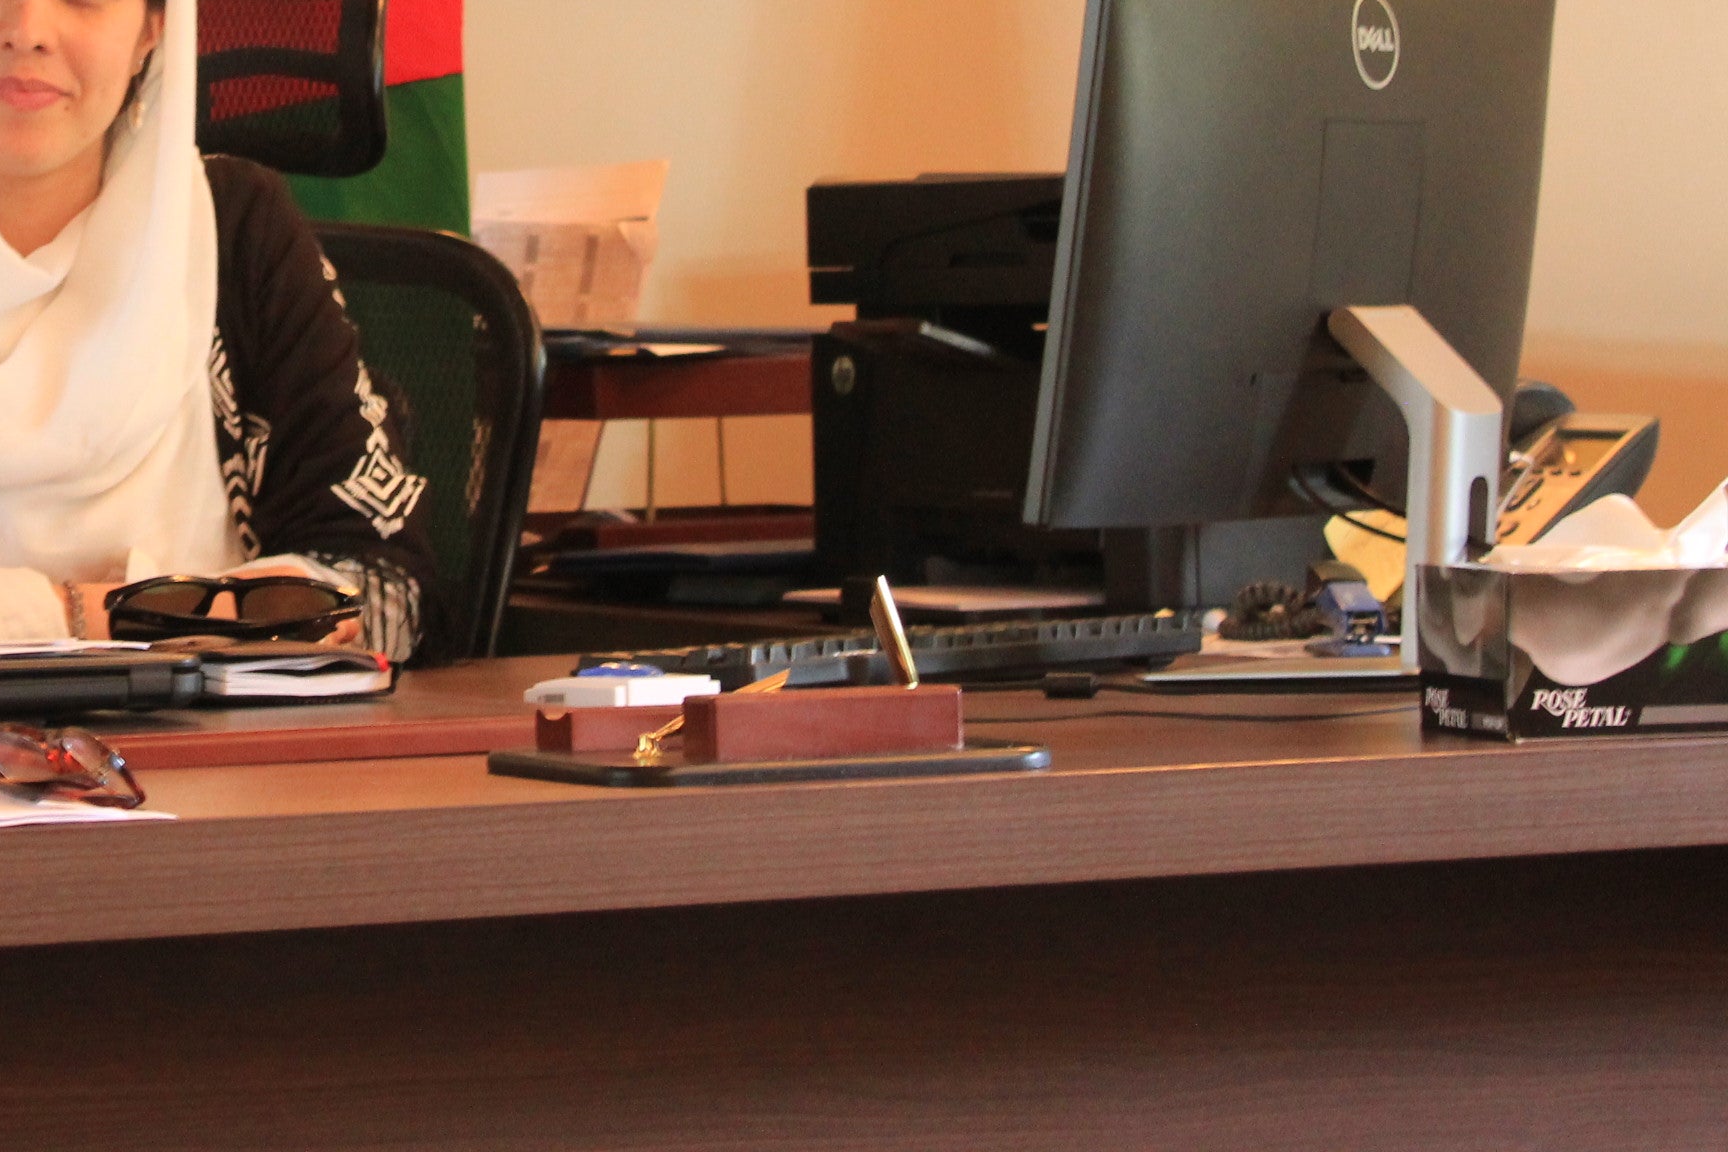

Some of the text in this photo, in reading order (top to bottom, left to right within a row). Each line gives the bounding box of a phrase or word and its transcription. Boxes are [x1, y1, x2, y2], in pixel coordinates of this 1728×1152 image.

[1357, 25, 1394, 53] DELL
[1530, 687, 1589, 716] ROSE
[1561, 704, 1629, 728] PETAL
